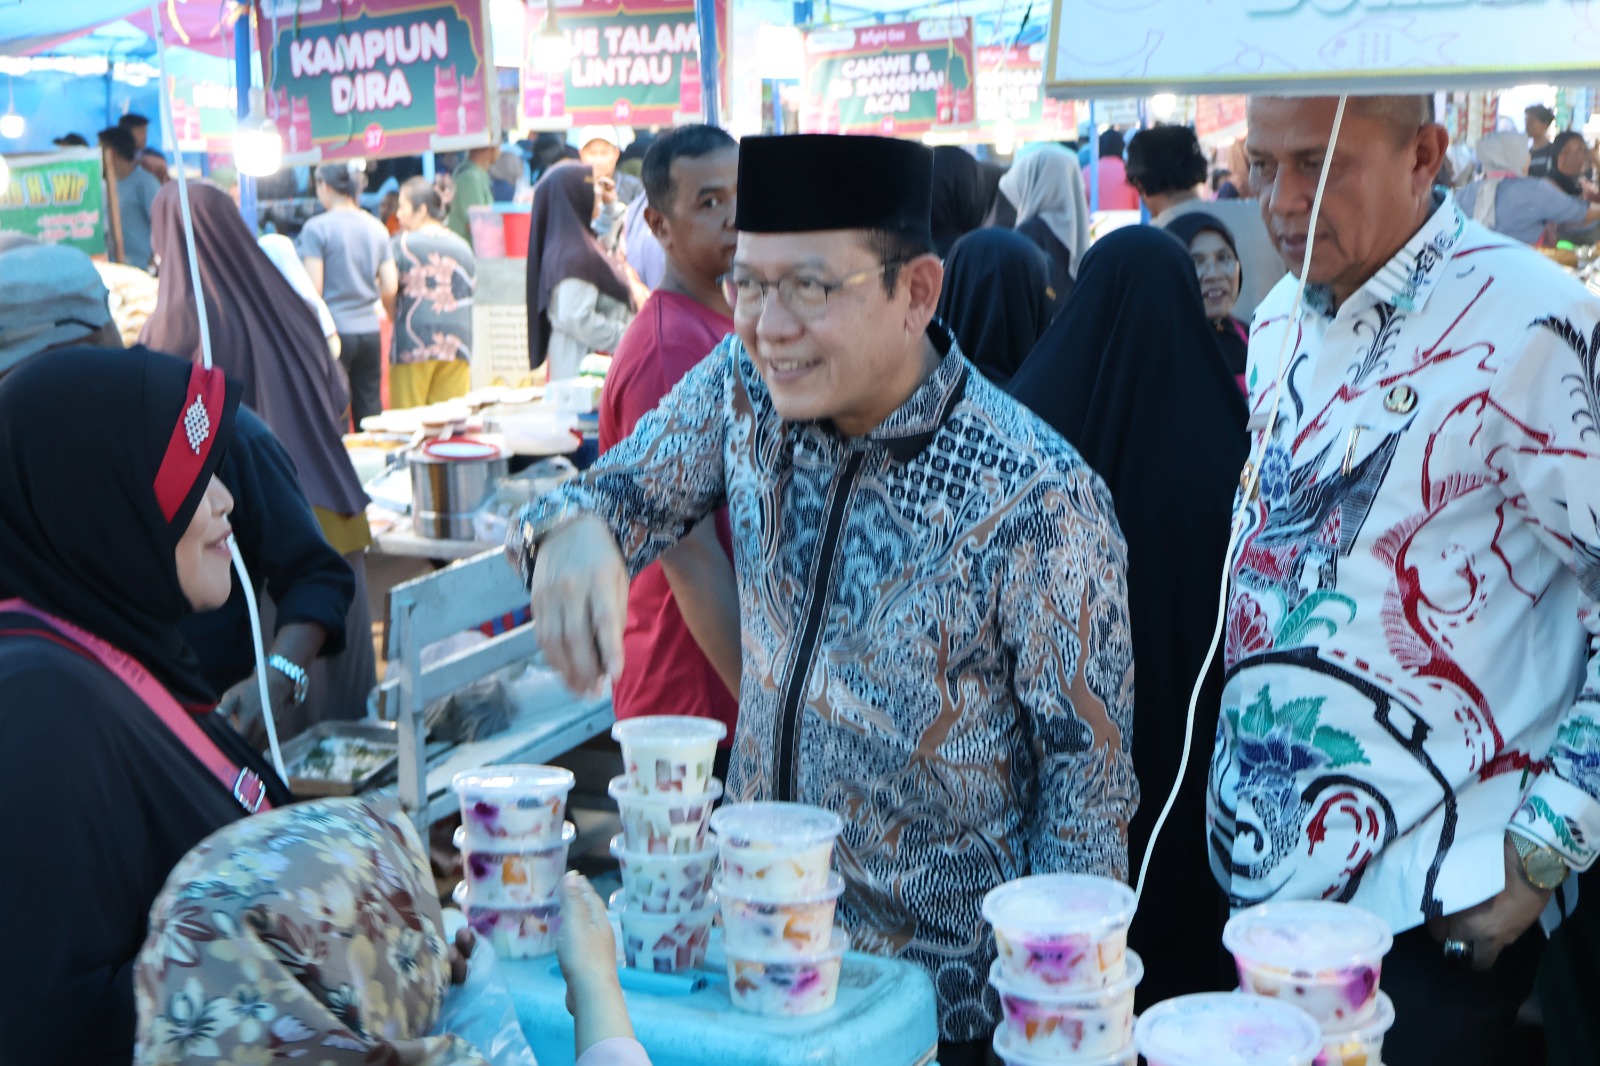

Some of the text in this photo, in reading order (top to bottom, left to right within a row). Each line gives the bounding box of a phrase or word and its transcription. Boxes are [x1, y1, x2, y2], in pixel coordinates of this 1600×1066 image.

[290, 19, 448, 78] KAMPIUN
[562, 22, 699, 58] UE TALAM
[331, 68, 412, 115] DIRA
[571, 54, 673, 88] LINTAU
